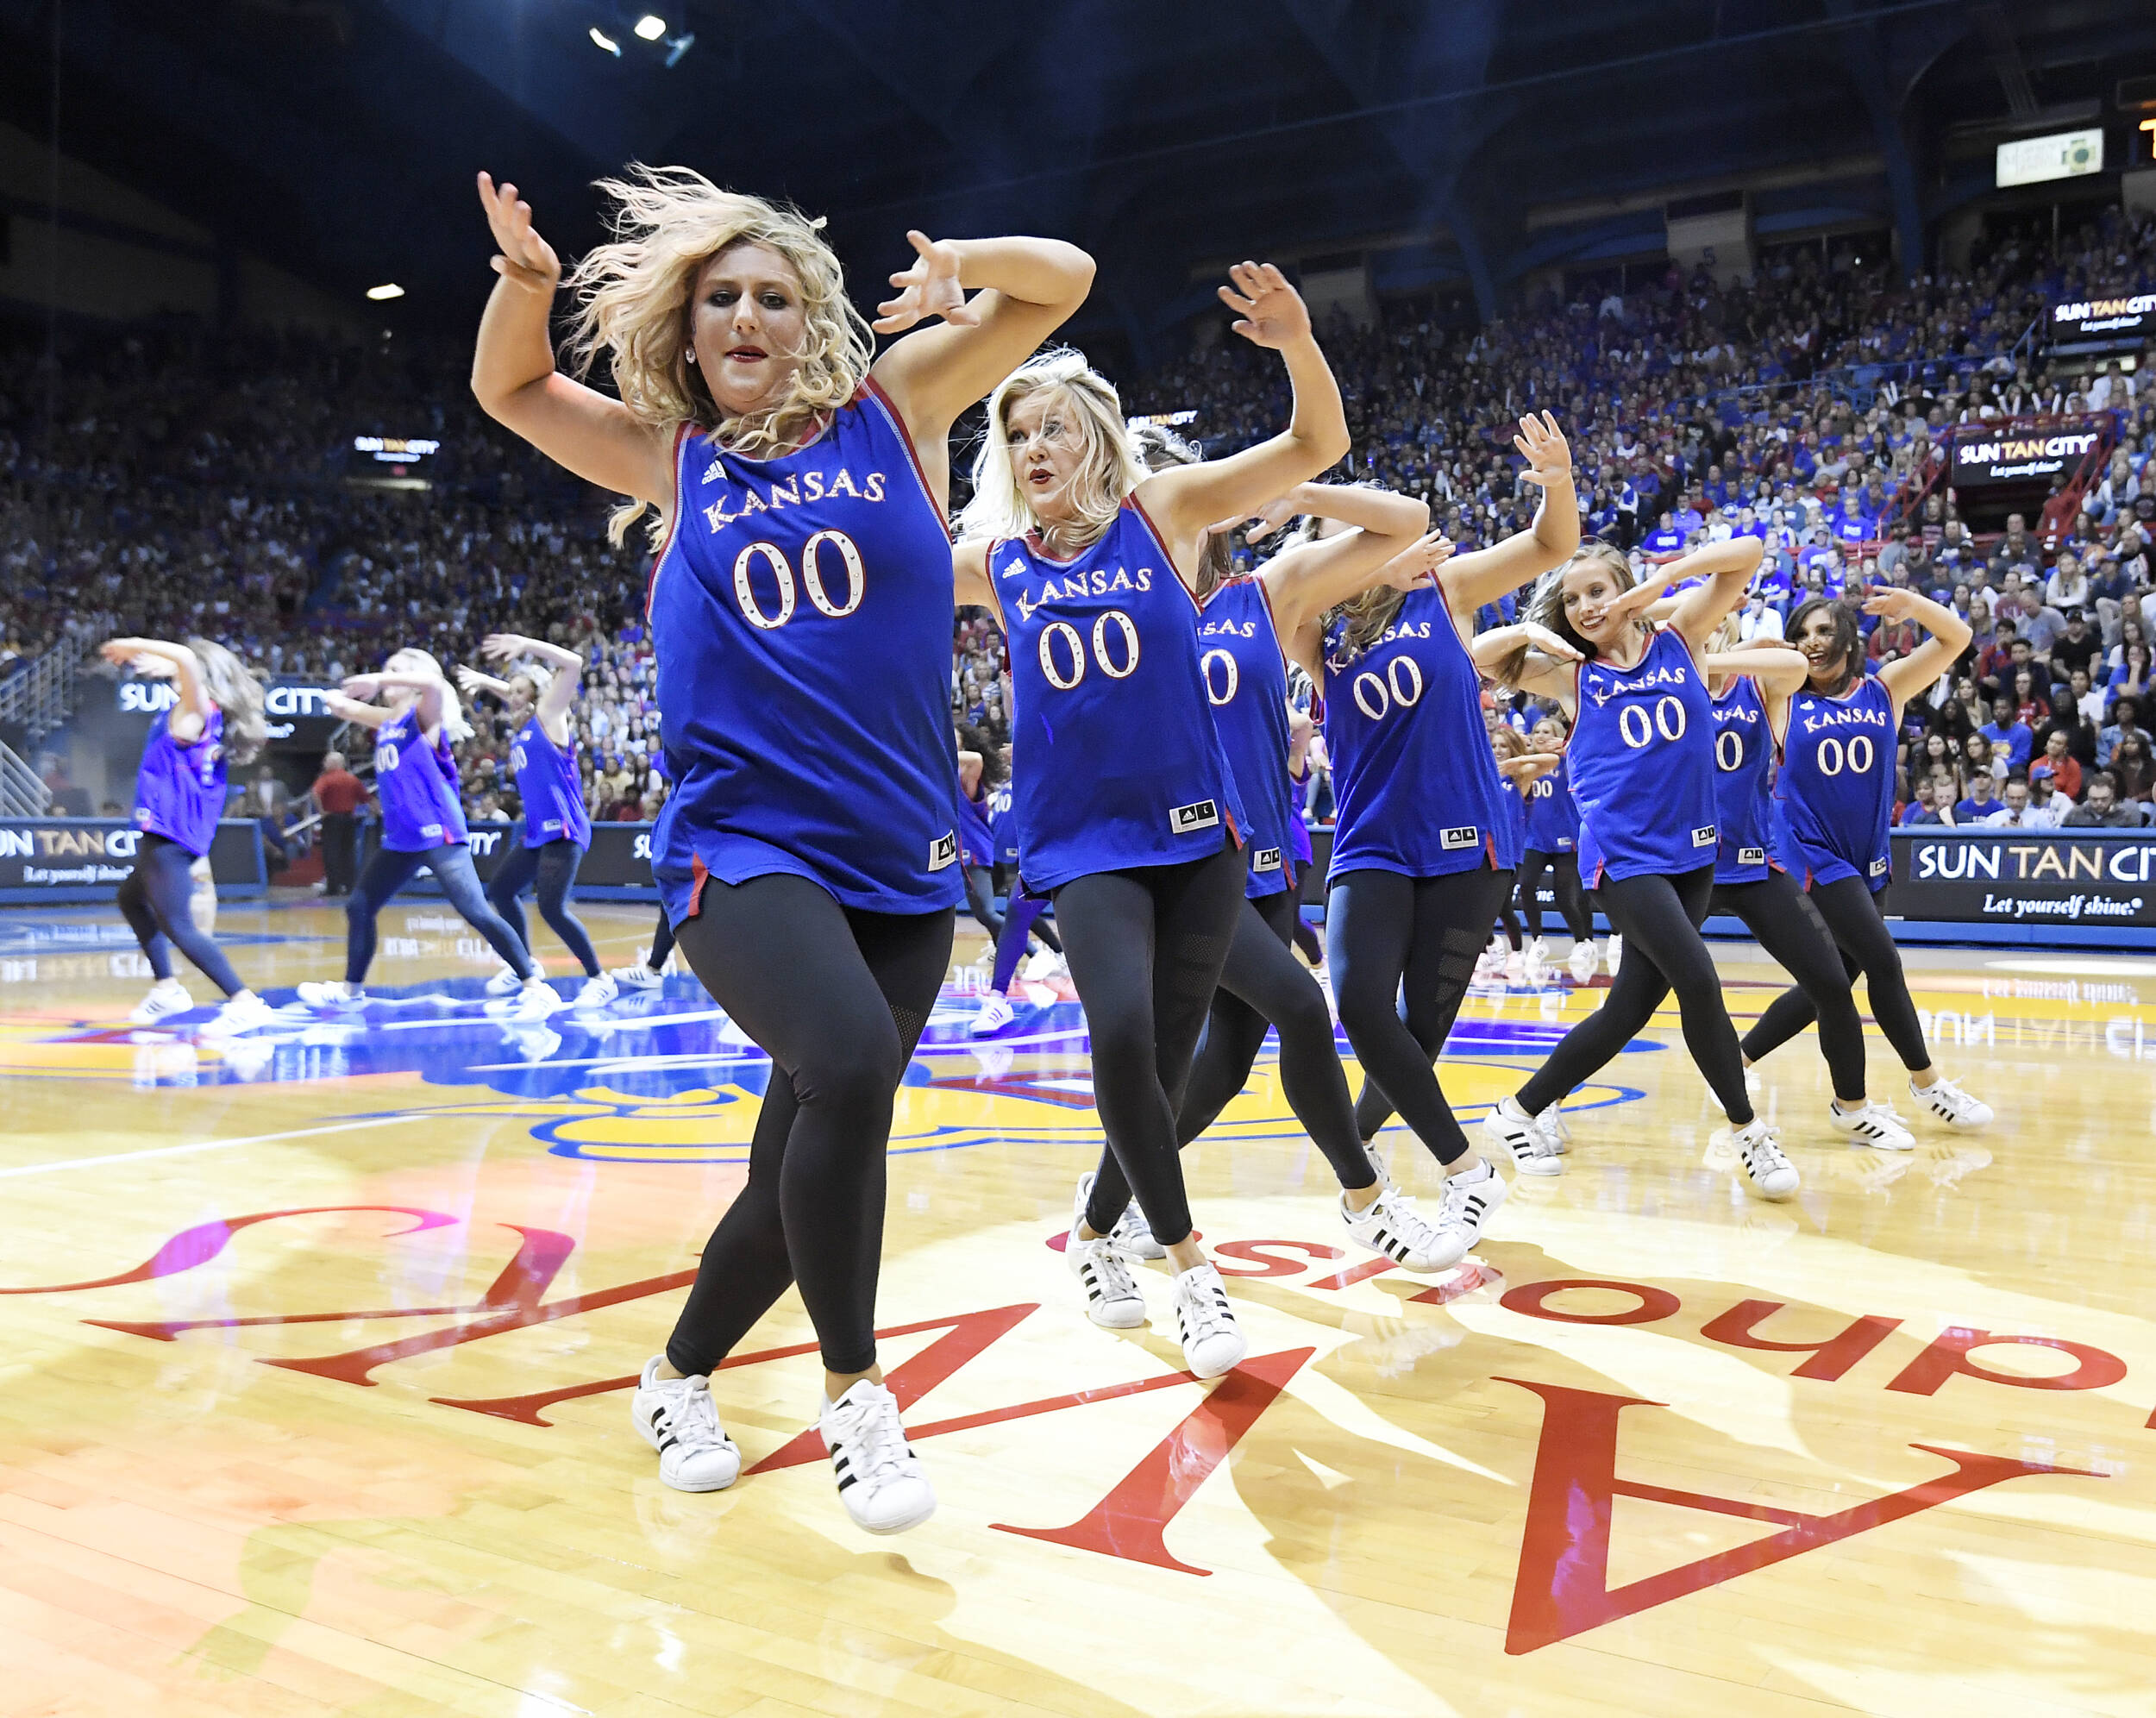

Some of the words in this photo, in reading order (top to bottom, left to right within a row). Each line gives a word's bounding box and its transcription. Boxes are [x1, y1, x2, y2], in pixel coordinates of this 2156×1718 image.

[2054, 302, 2090, 323] SUN
[2090, 298, 2127, 317] TAN
[2126, 294, 2156, 314] CIT
[1150, 415, 1173, 426] TAN
[1959, 442, 2001, 465] SUN
[2001, 439, 2046, 460] TAN
[2045, 433, 2097, 457] CITY
[702, 467, 887, 535] KANSAS
[732, 528, 866, 630] 00
[1015, 566, 1153, 623] KANSAS
[1198, 618, 1257, 638] SAS
[1037, 608, 1140, 691] 00
[119, 683, 181, 712] SUN
[1352, 655, 1423, 721] 00
[1591, 665, 1687, 709] KANSAS
[1618, 695, 1687, 749] 00
[1802, 706, 1887, 734] KANSAS
[1816, 735, 1874, 777] 00
[1531, 780, 1553, 798] 00
[35, 829, 105, 856] TAN
[1918, 844, 2001, 880] SUN
[2008, 845, 2103, 881] TAN
[1984, 893, 2013, 912] Let
[2014, 894, 2085, 919] yourself
